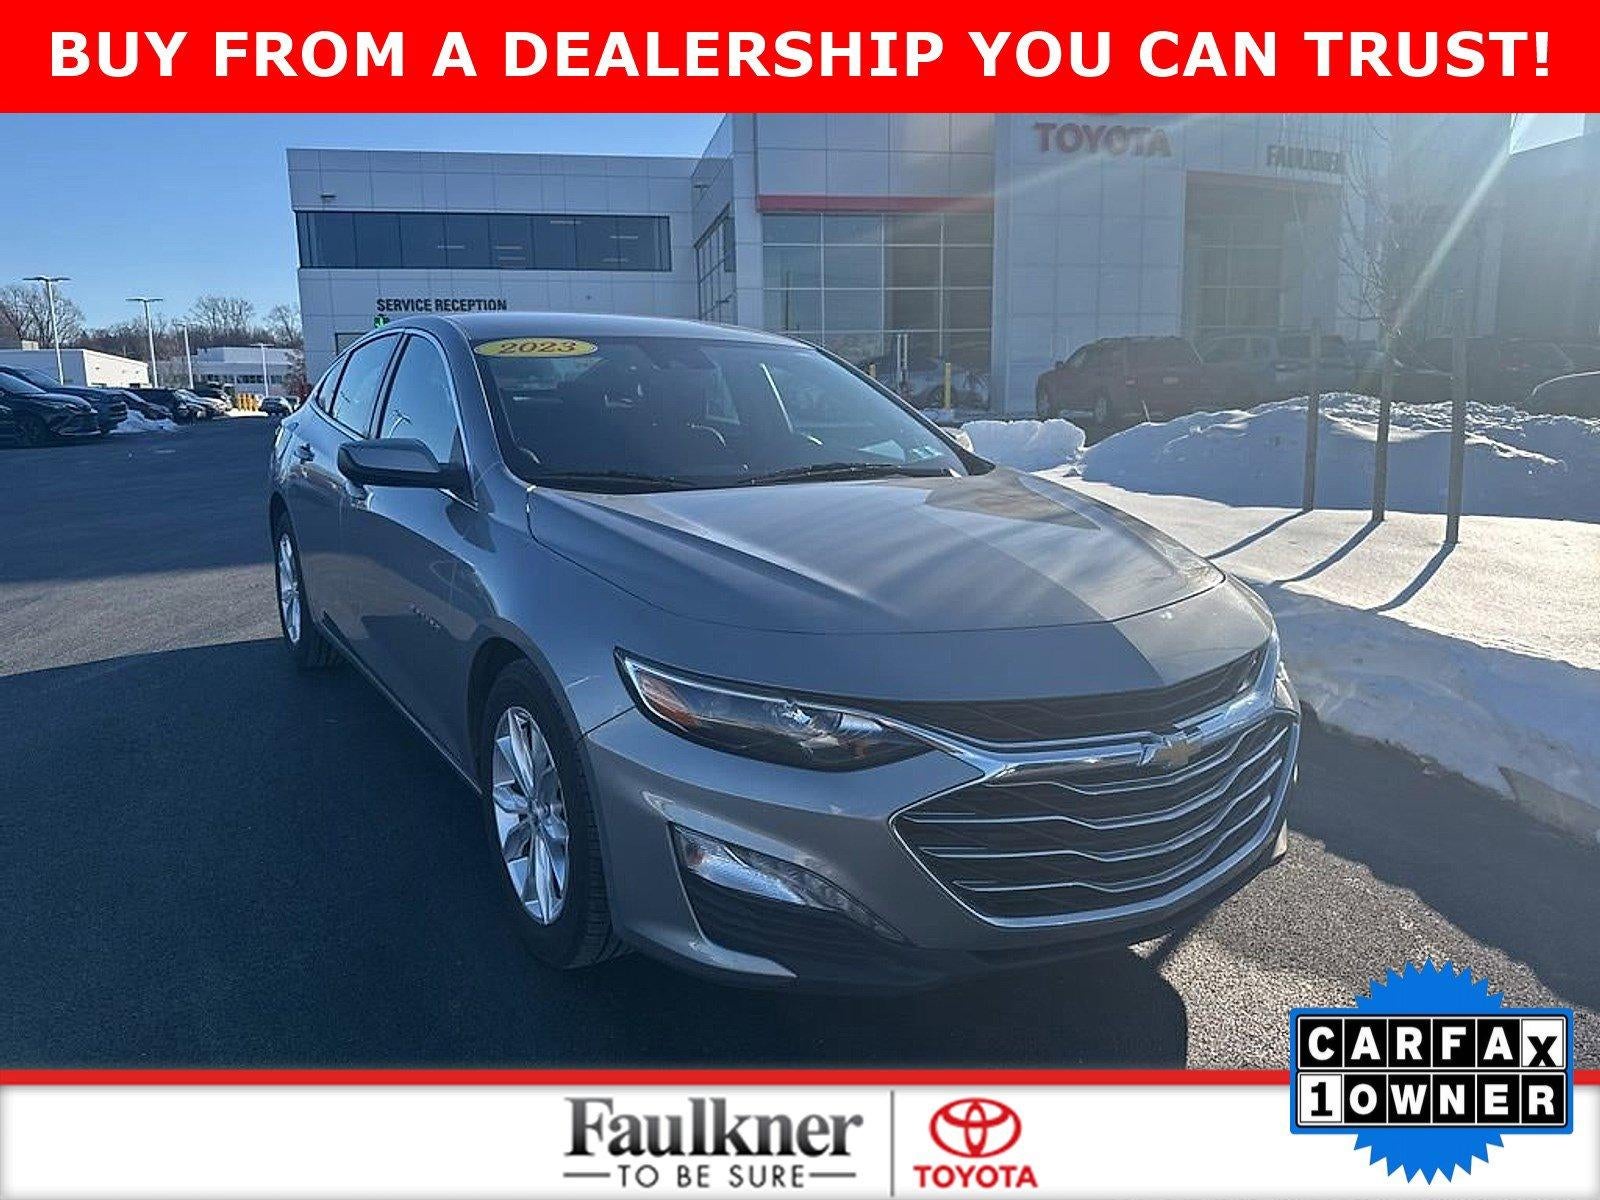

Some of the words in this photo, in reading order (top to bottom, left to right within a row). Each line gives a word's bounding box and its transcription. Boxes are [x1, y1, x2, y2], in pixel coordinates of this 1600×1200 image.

[1034, 122, 1172, 157] TOYOTA
[377, 299, 432, 311] SERVICE
[435, 299, 507, 311] RECEPTION
[500, 341, 577, 355] 2023
